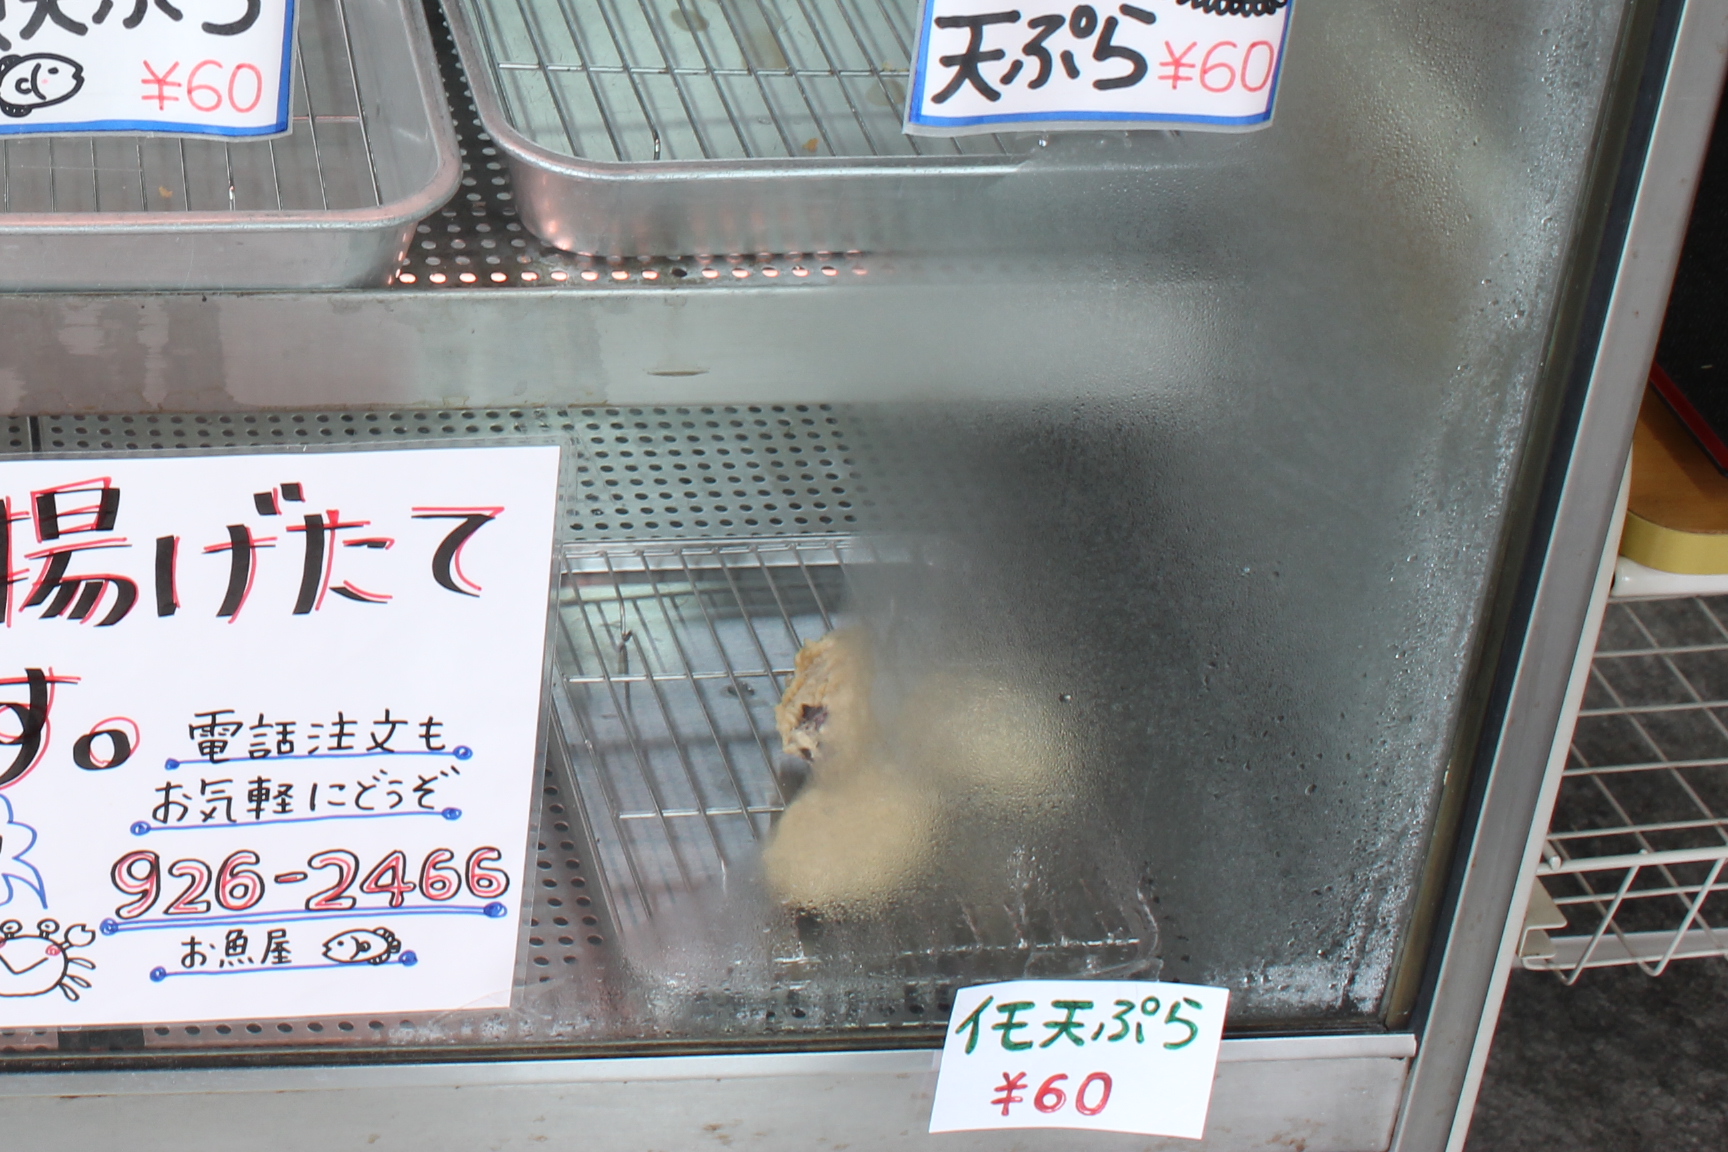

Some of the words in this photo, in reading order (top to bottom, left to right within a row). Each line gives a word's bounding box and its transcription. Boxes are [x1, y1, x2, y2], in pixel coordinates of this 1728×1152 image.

[931, 3, 1157, 105] 天ぷら
[1158, 40, 1273, 93] ¥60
[141, 59, 263, 113] ¥60
[188, 709, 447, 763] 電話注文も
[152, 765, 460, 825] お気軽にどうぞ
[110, 847, 510, 920] 926-2466
[180, 928, 292, 969] お魚屋
[955, 995, 1203, 1055] イモ天ぷら
[990, 1071, 1113, 1117] ¥60
